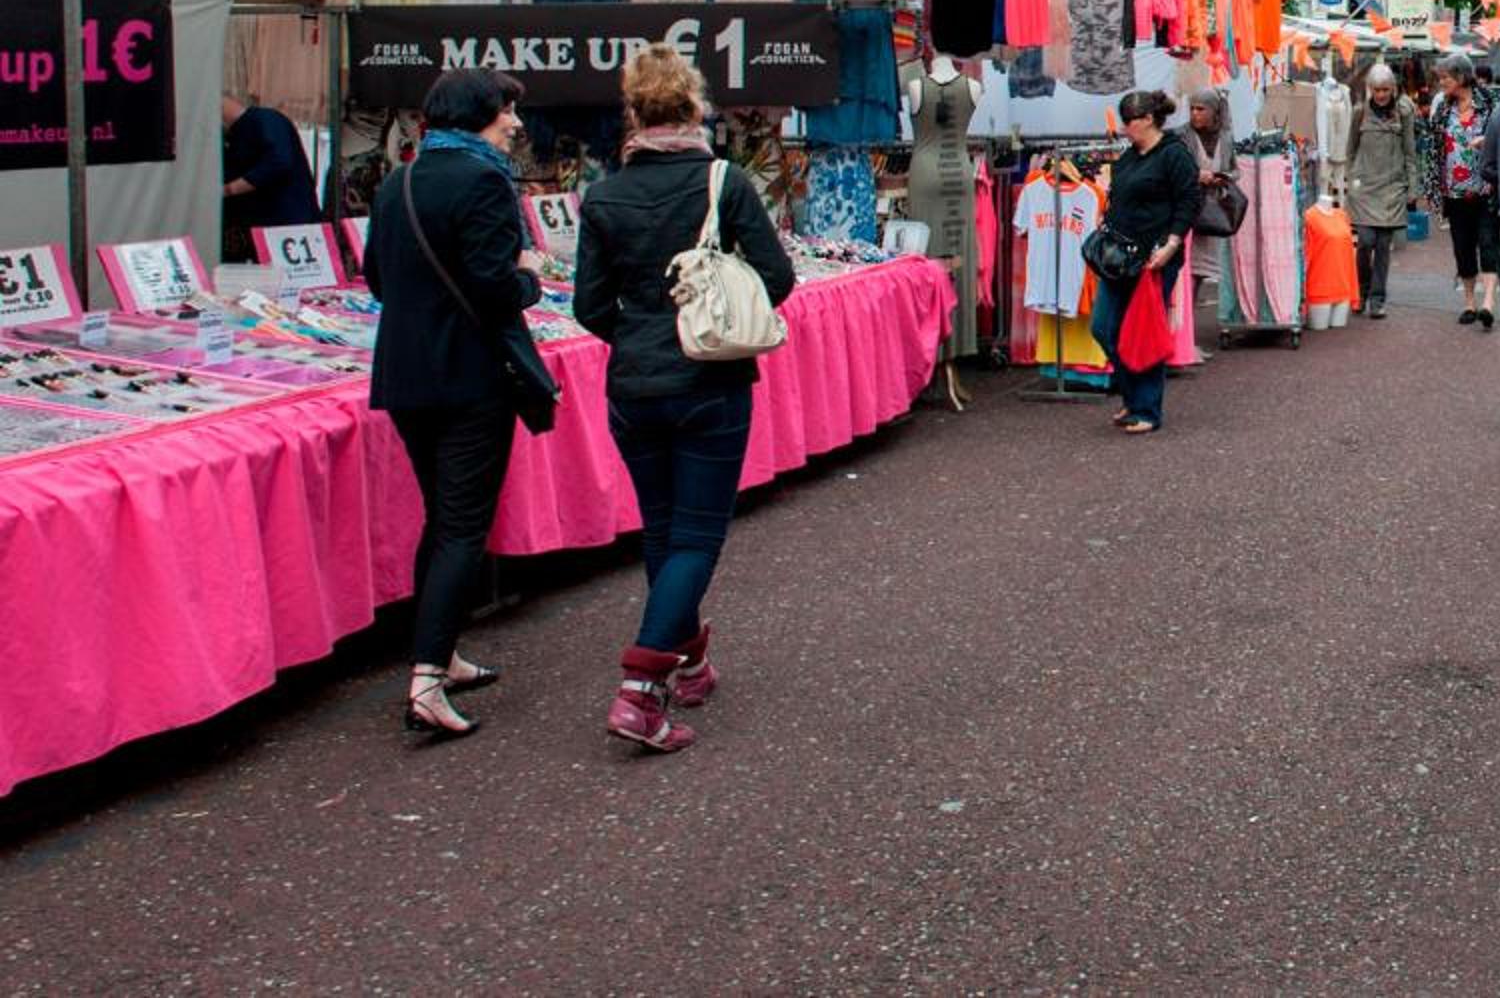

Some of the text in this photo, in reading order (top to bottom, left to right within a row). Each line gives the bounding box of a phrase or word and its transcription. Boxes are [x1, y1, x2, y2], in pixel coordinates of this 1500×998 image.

[372, 42, 420, 56] FOGAN
[440, 37, 576, 71] MAKE
[763, 41, 812, 55] FOGAN
[281, 235, 318, 265] €1
